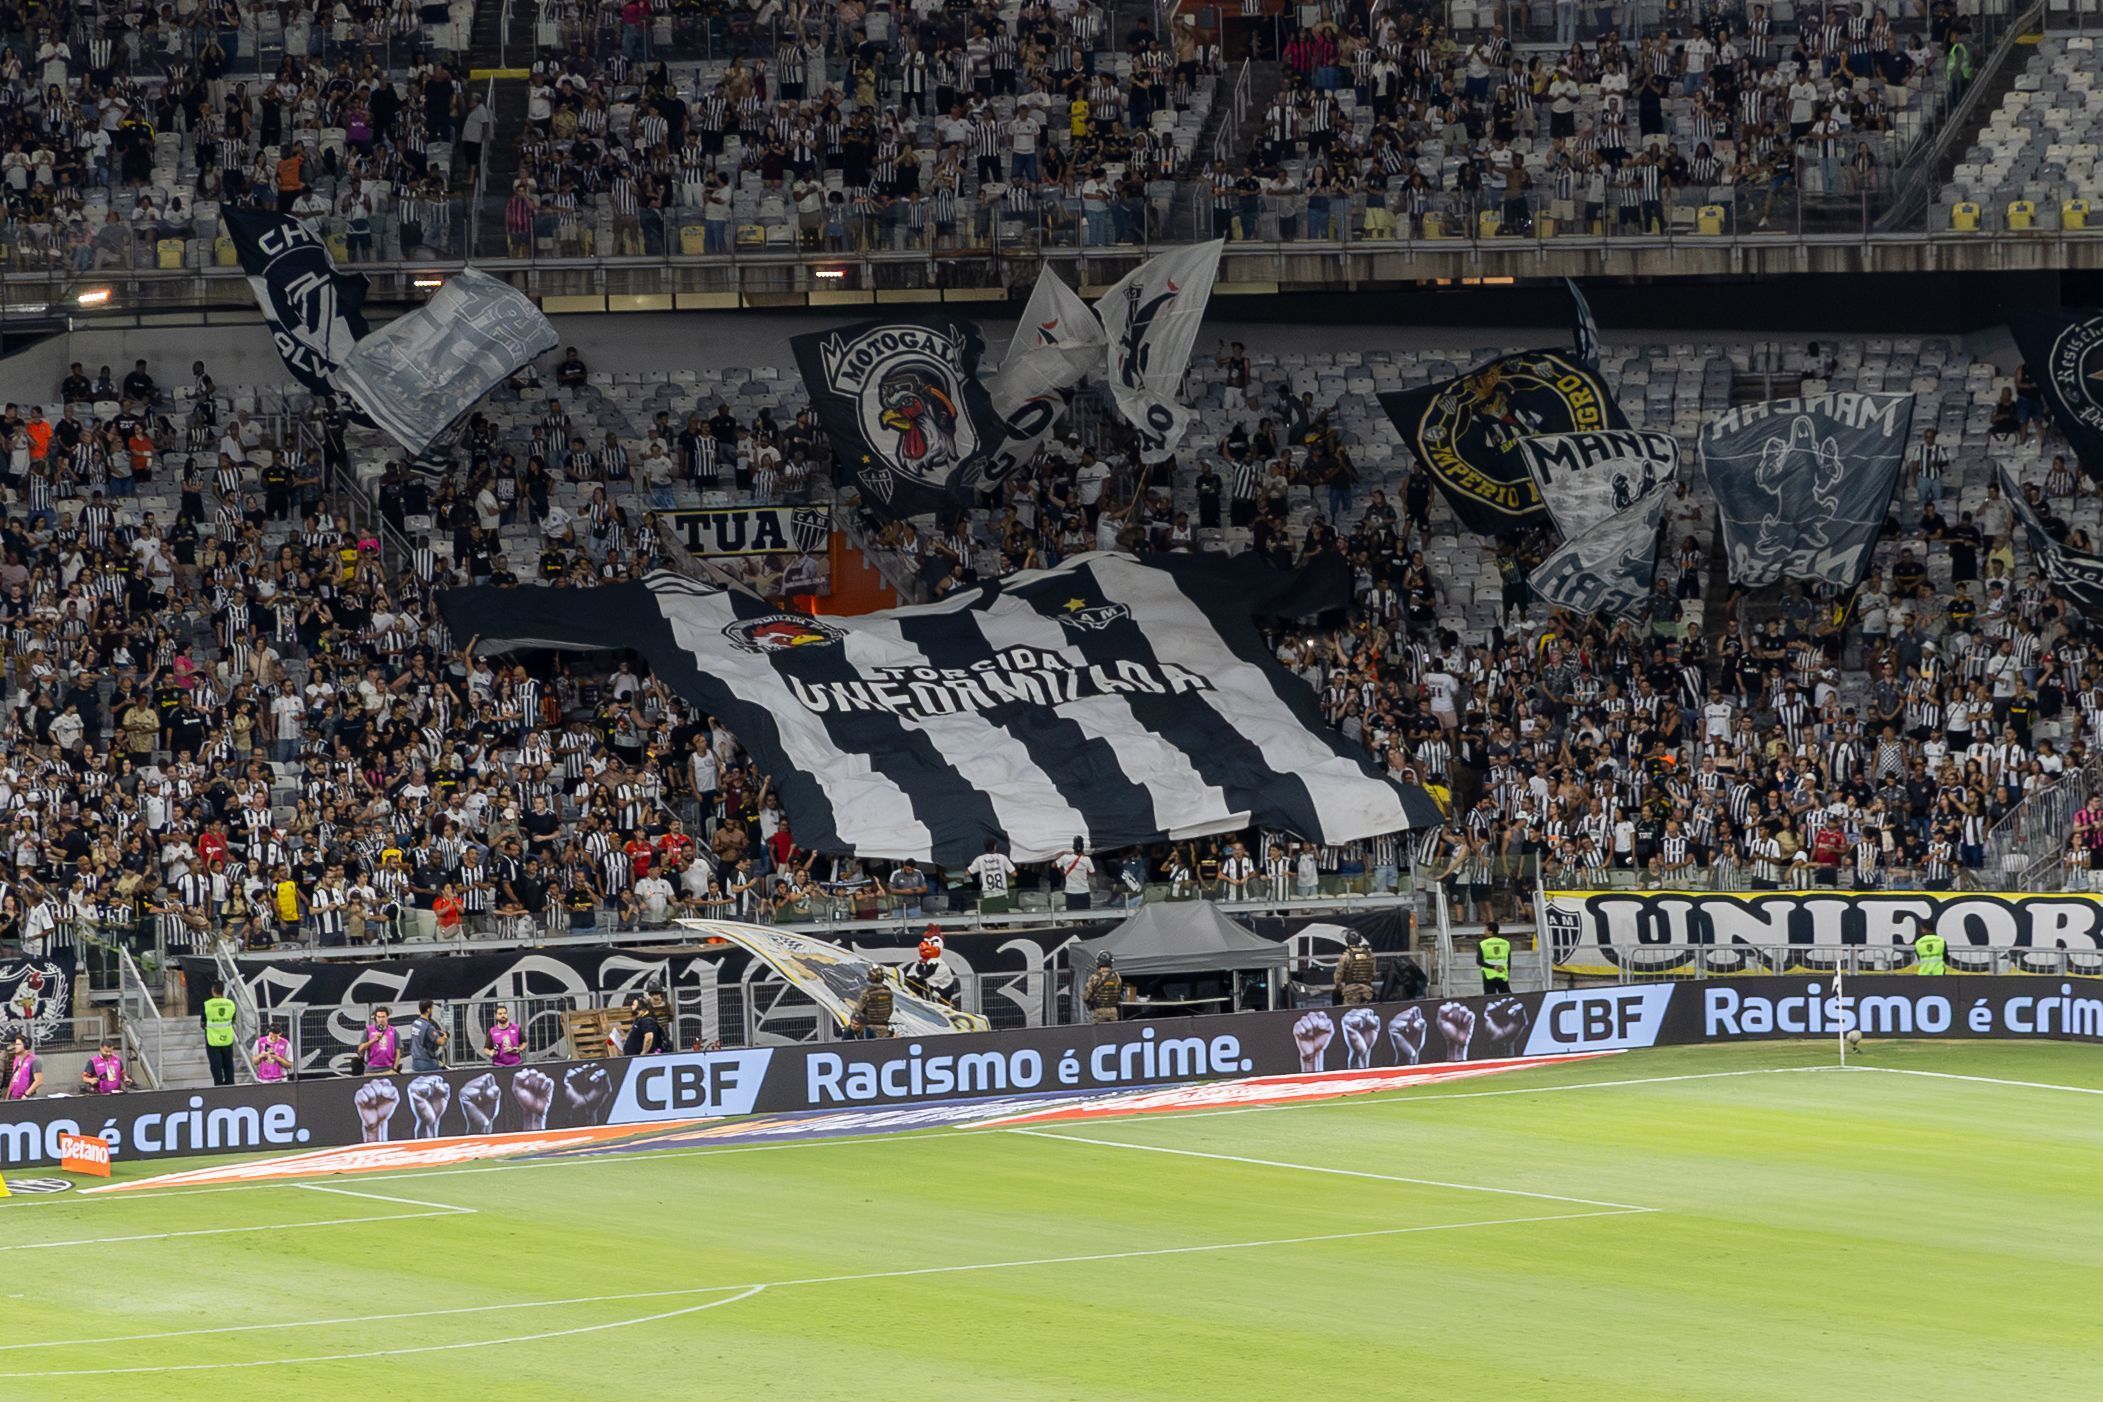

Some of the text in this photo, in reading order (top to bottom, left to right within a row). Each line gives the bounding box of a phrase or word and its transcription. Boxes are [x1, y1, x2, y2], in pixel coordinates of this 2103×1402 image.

[675, 510, 787, 552] TUA
[796, 514, 826, 527] CAM
[1080, 607, 1118, 622] AM
[880, 648, 1066, 681] TORCIDA
[985, 873, 1005, 890] 98
[1548, 914, 1574, 927] AM
[1592, 897, 2103, 972] UNIFOR
[1548, 995, 1645, 1045] CBF
[1704, 983, 1949, 1036] Racismo
[1967, 998, 1992, 1033] é
[634, 1060, 743, 1112] CBF
[806, 1027, 1254, 1104] Racismo é crime.
[133, 1095, 311, 1152] crime.
[61, 1136, 109, 1165] Betano
